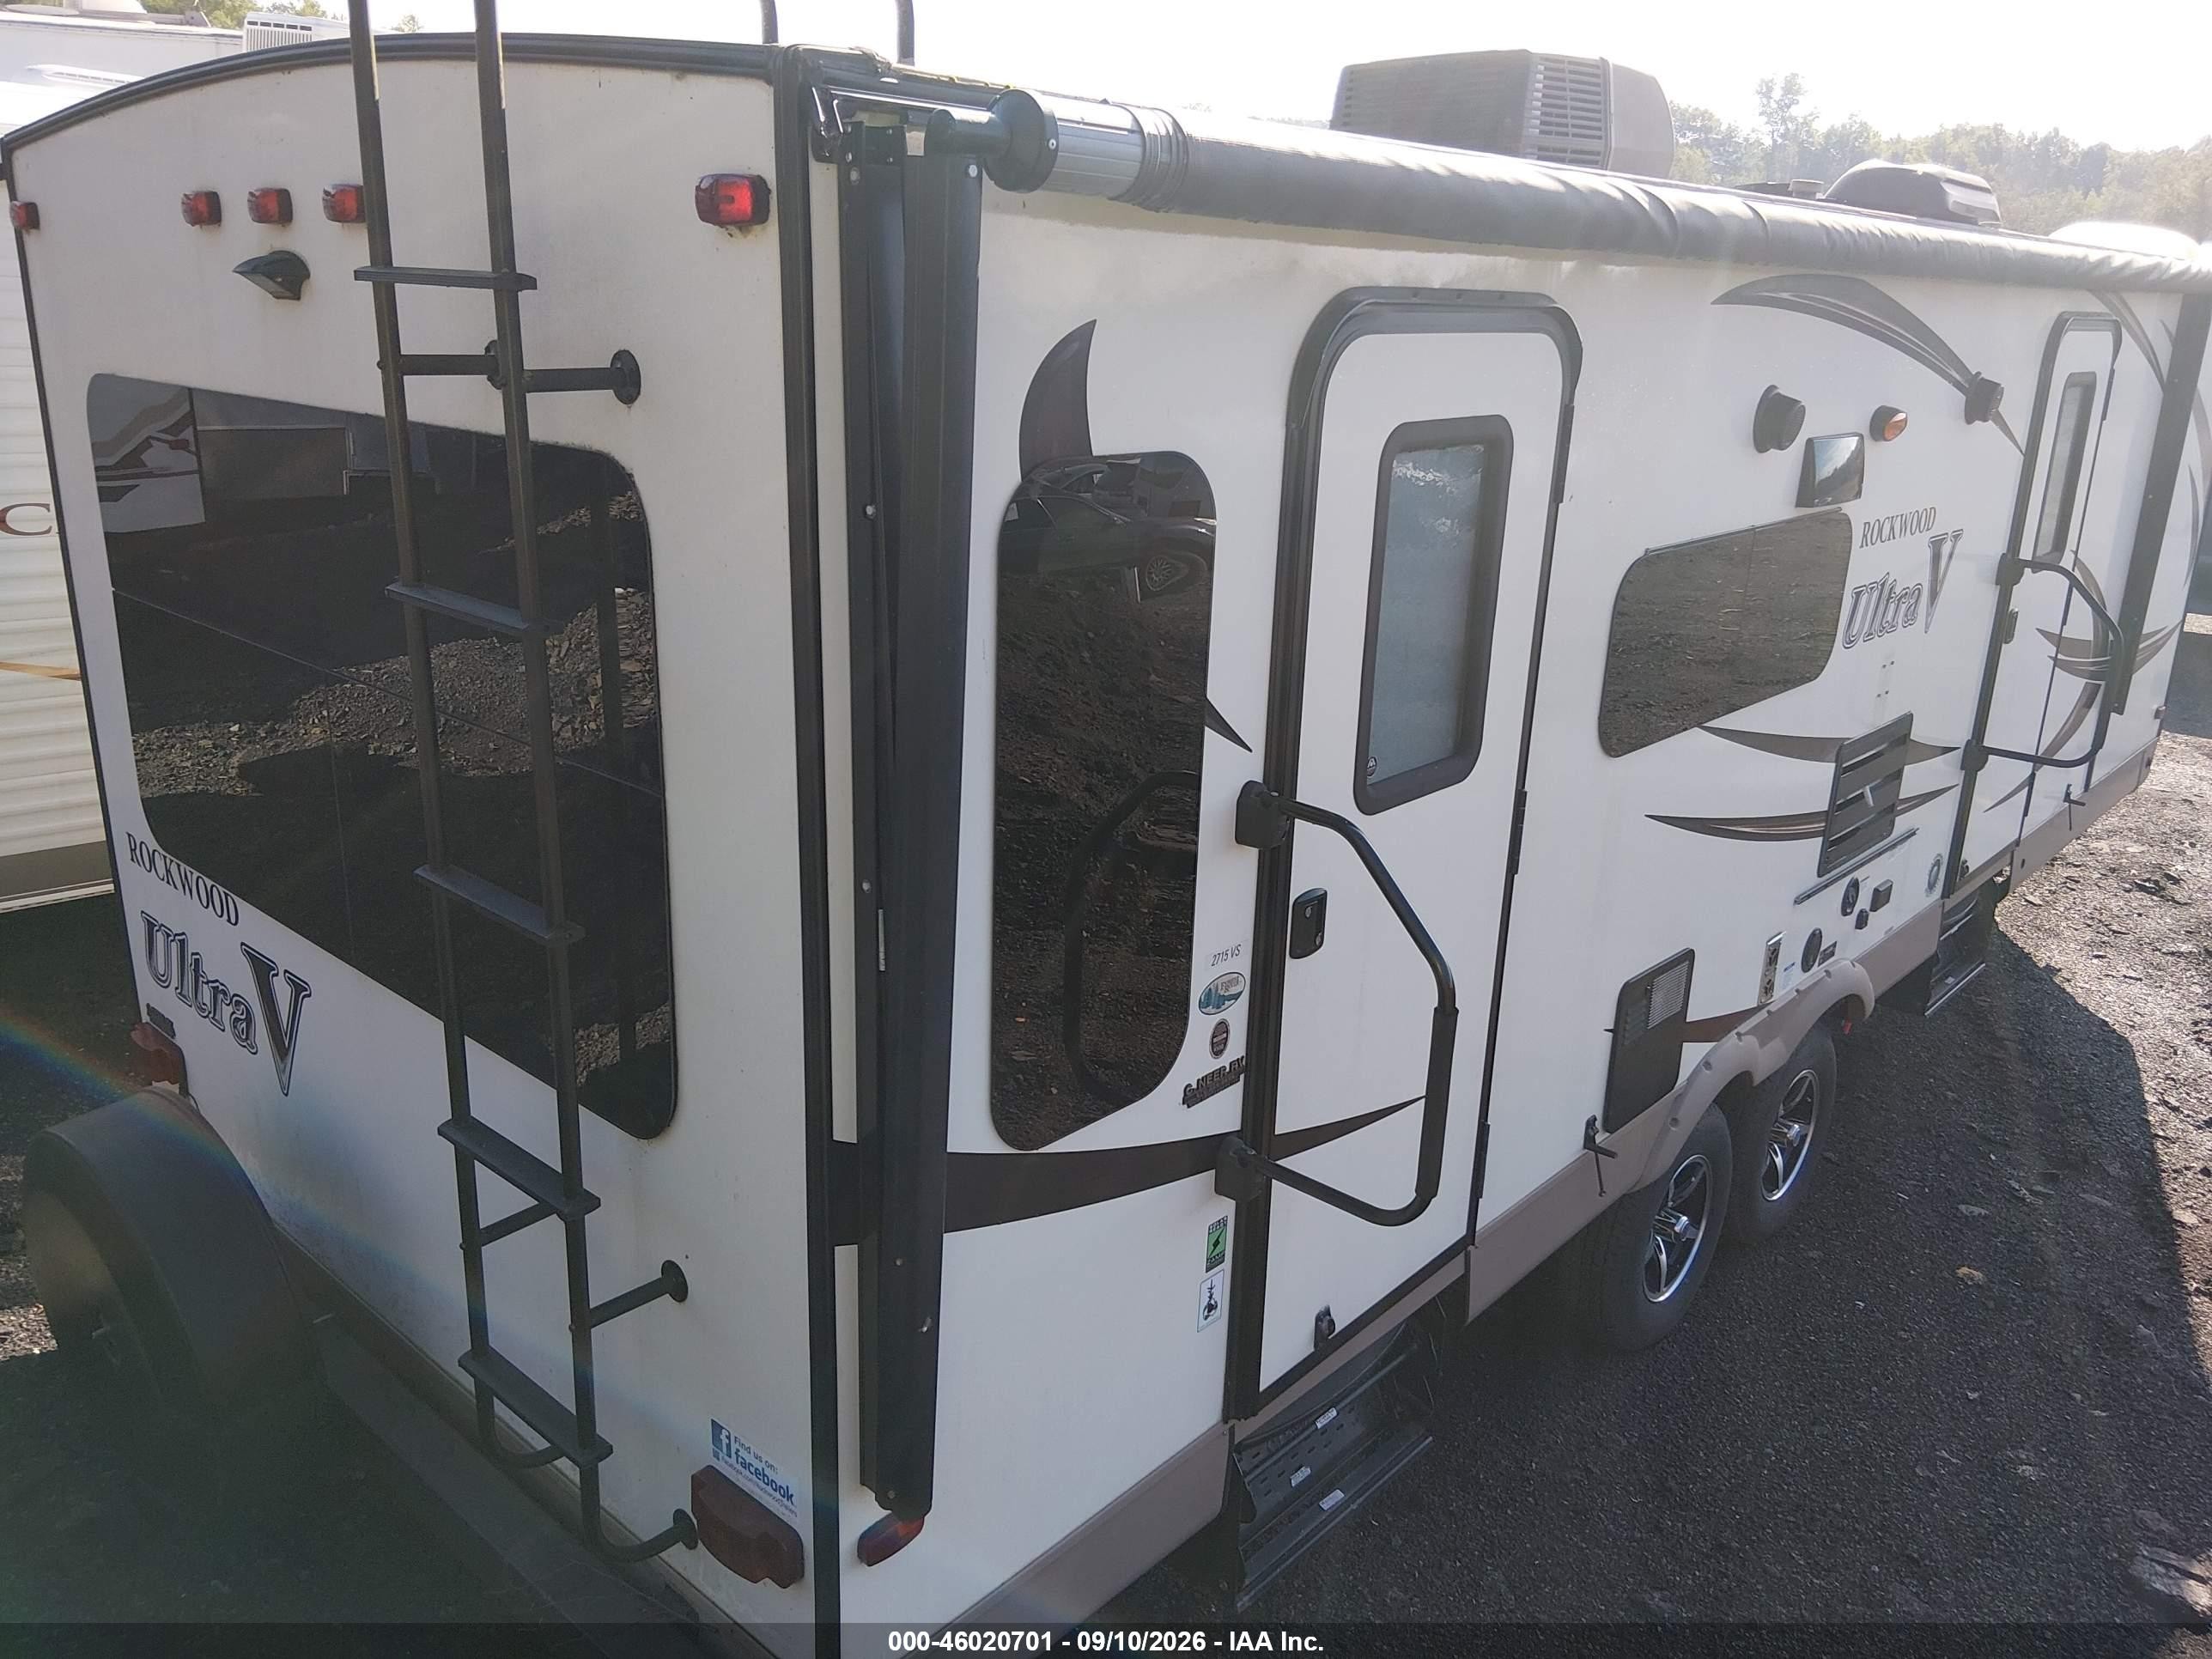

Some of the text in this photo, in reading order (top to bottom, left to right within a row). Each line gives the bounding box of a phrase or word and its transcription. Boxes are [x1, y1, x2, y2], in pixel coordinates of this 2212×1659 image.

[1859, 507, 1936, 549] ROCKWOOD
[1842, 529, 1964, 649] Ultra V
[125, 831, 240, 927] ROCKWOOD
[1211, 944, 1242, 967] 2715 VS
[141, 909, 312, 1097] Ultra V
[734, 1435, 751, 1455] Find
[753, 1450, 763, 1463] us
[734, 1448, 794, 1504] facebook
